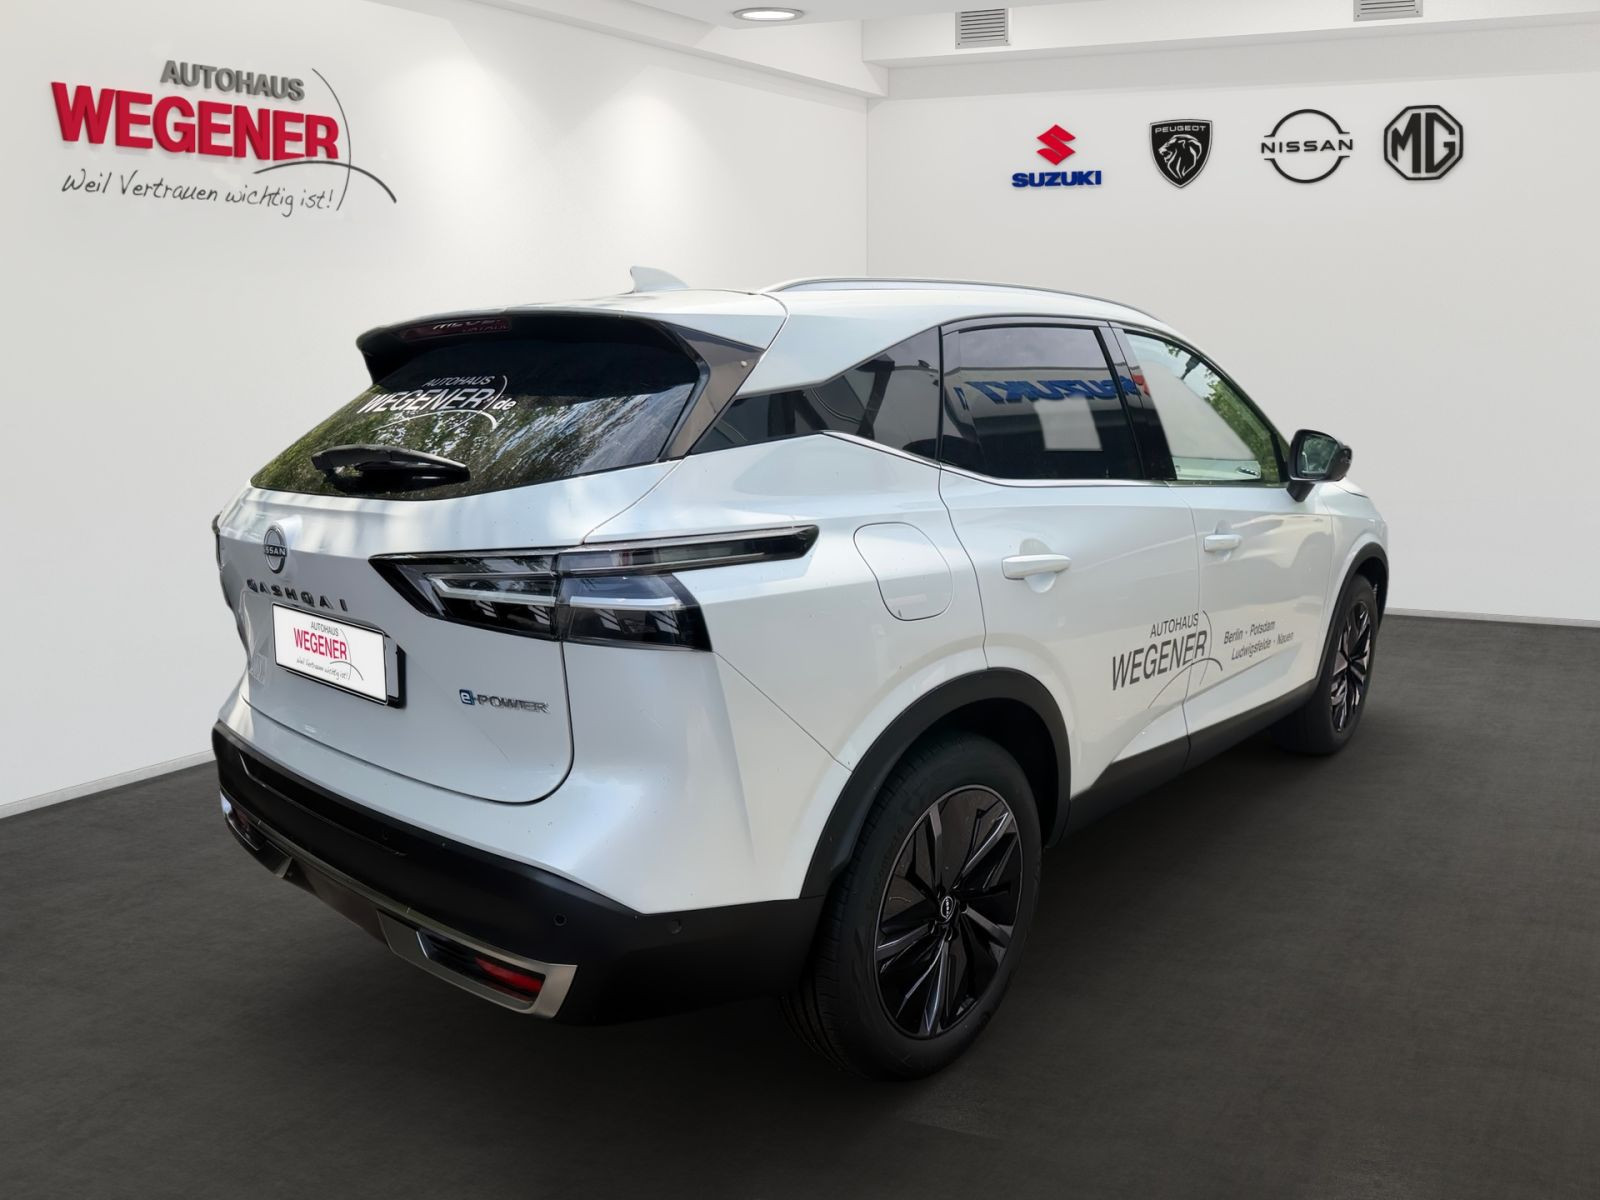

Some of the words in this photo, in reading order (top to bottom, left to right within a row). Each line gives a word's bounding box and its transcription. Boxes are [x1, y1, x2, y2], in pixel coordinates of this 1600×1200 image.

[160, 60, 305, 100] AUTOHAUS
[51, 81, 339, 161] WEGENER
[1154, 125, 1206, 133] PEUGEOT
[1261, 138, 1353, 154] NISSAN
[1391, 112, 1455, 174] MG
[1011, 170, 1102, 188] SUZUKI
[62, 168, 112, 194] Weil
[120, 169, 218, 202] Vertrauen
[225, 185, 294, 218] wichtig
[300, 188, 334, 211] ist!
[422, 375, 496, 387] AUTOHAUS
[357, 388, 496, 414] WEGENER
[246, 578, 348, 612] QASHQAI
[310, 620, 339, 637] AUTOHAUS
[1149, 613, 1200, 638] AUTOHAUS
[1223, 629, 1244, 645] Berlin
[1250, 620, 1276, 636] Potsdam
[293, 627, 348, 661] WEGENER
[1277, 631, 1294, 646] Nauen
[1112, 630, 1208, 691] WEGENER
